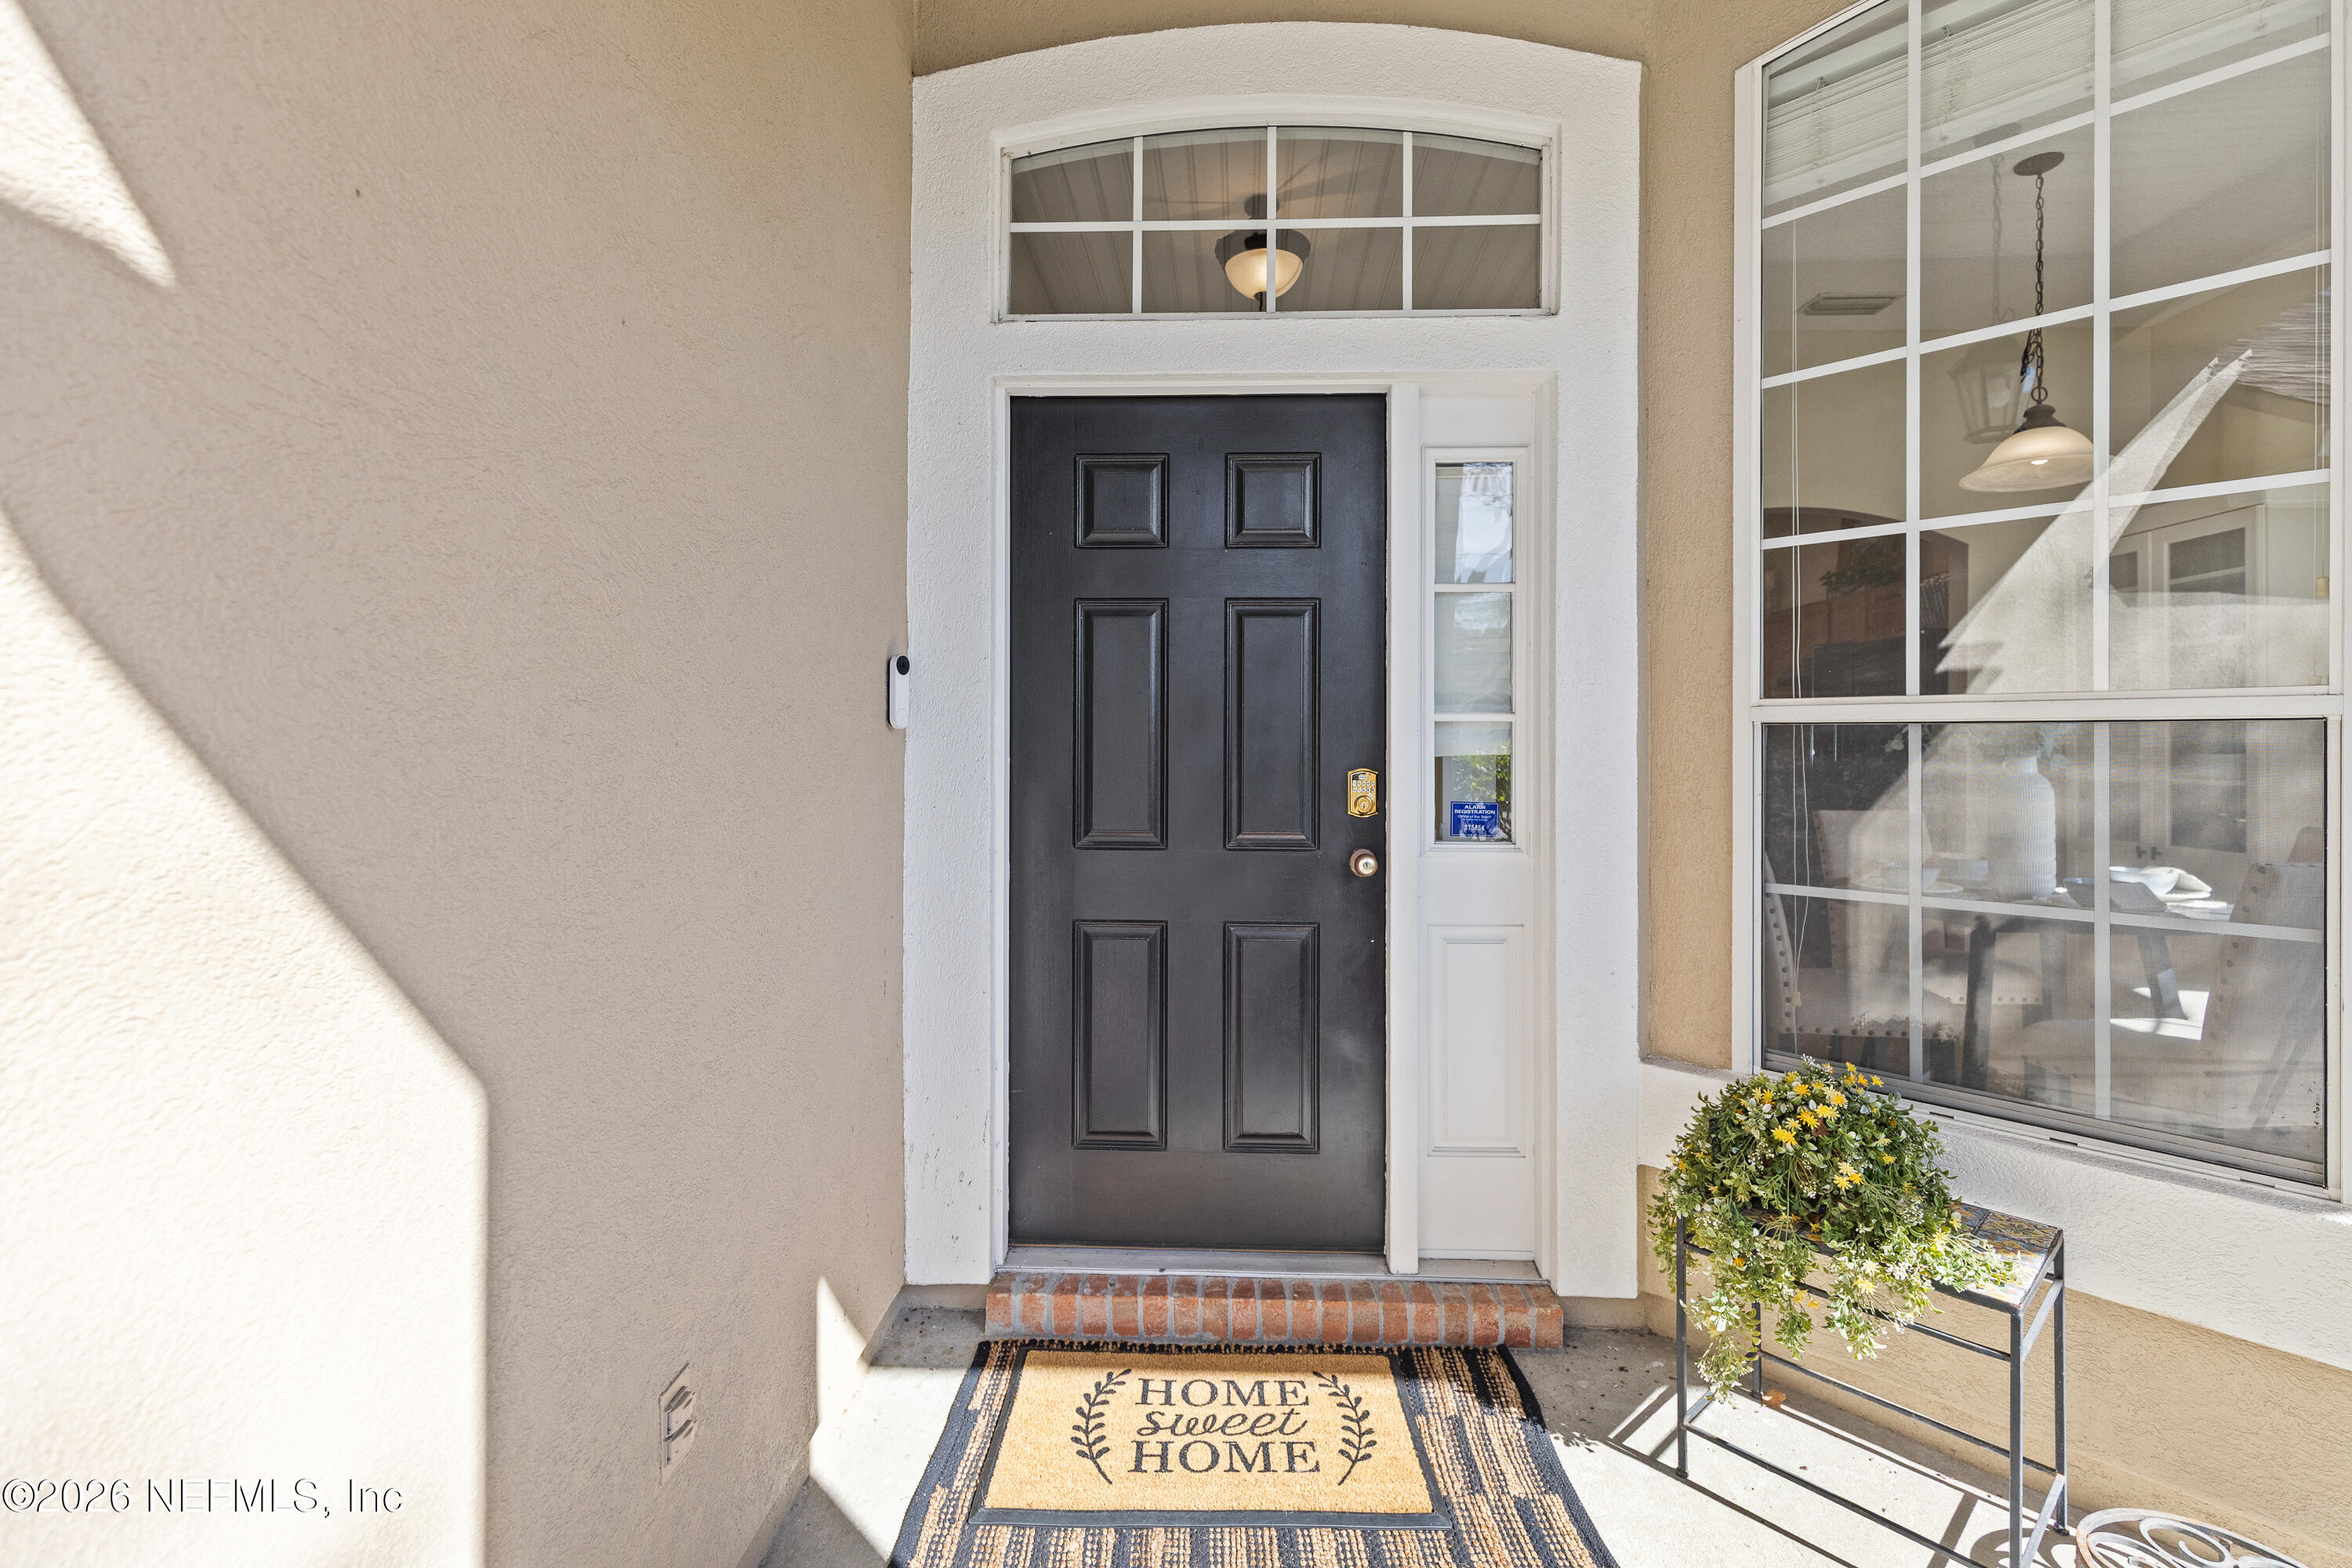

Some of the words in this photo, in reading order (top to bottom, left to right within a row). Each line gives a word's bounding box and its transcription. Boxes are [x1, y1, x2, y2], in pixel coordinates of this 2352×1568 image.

[1134, 1377, 1309, 1406] HOME
[1136, 1407, 1308, 1436] sweet
[1127, 1439, 1320, 1474] HOME
